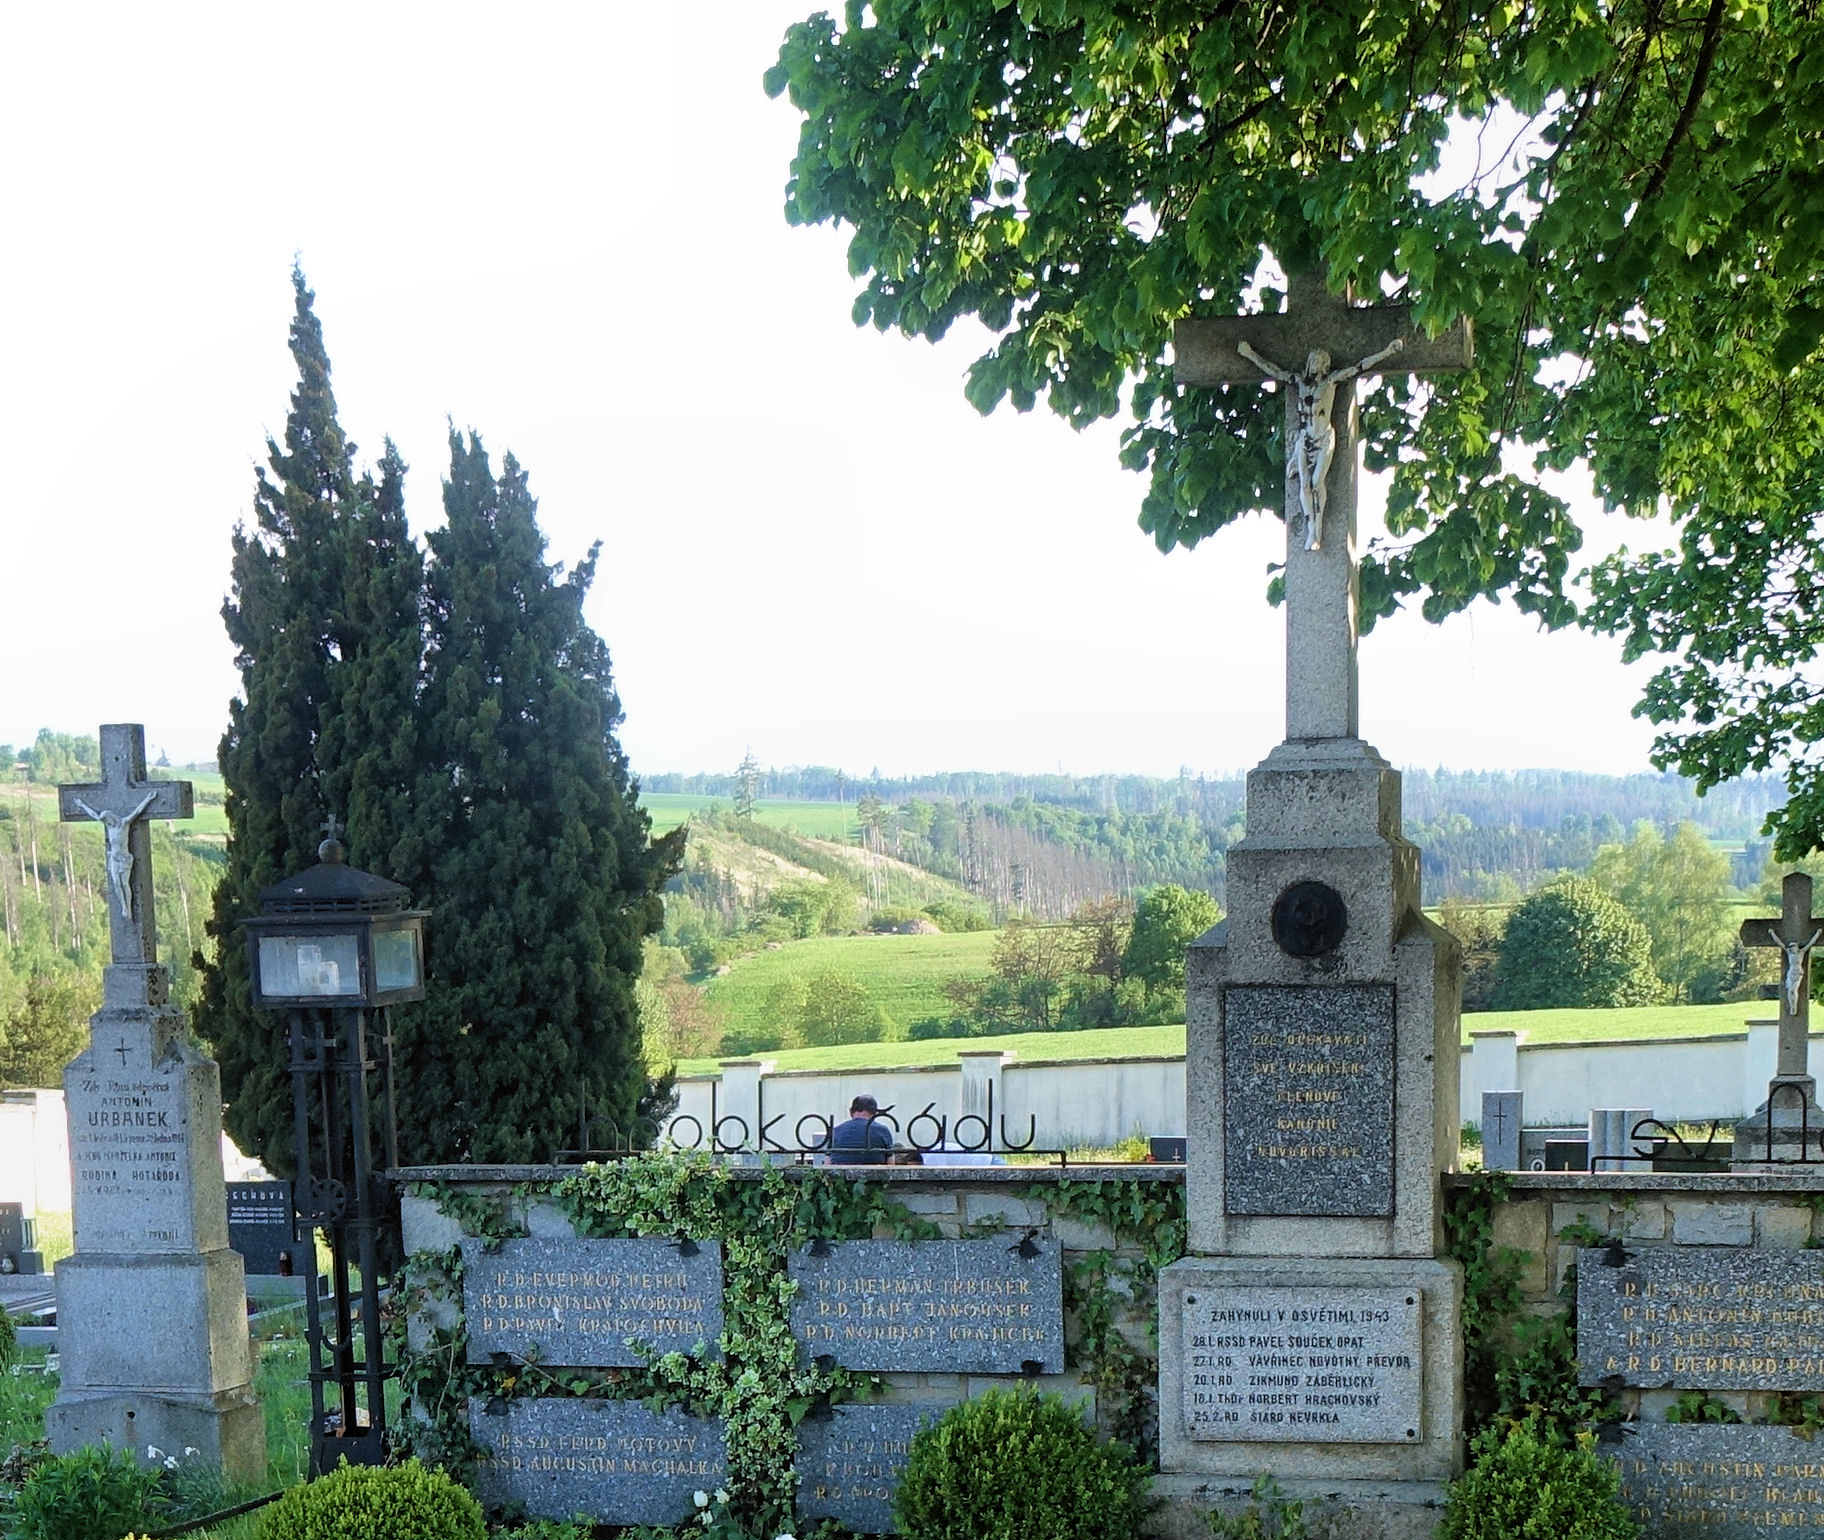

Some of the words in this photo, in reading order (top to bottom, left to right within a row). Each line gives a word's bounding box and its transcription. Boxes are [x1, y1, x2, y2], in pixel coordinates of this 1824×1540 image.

[579, 1078, 835, 1152] hrobka
[865, 1078, 1037, 1151] řádu
[226, 1187, 284, 1200] ECHOVA
[1211, 1309, 1271, 1323] ZAHYNULI
[1277, 1310, 1285, 1322] V
[1249, 1336, 1284, 1348] PAVEL
[1337, 1336, 1364, 1348] OPAT
[1248, 1393, 1299, 1405] NORBERT
